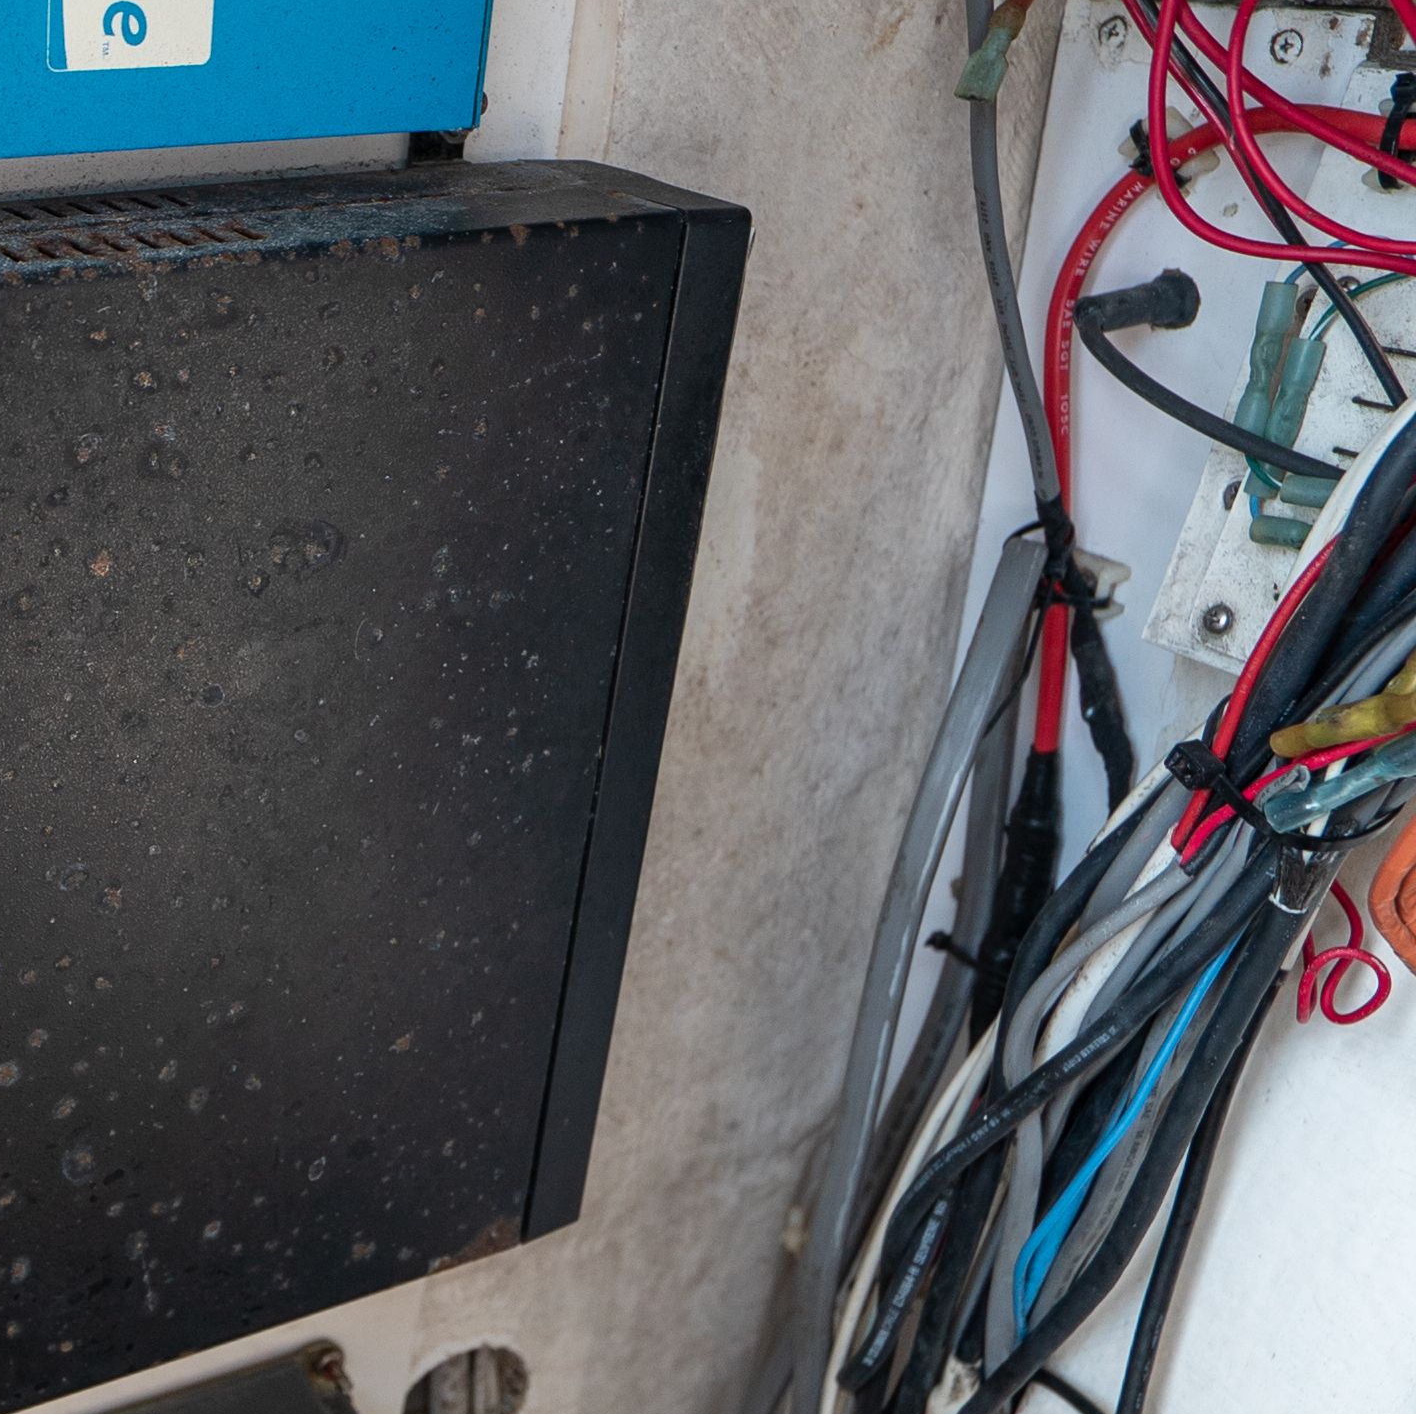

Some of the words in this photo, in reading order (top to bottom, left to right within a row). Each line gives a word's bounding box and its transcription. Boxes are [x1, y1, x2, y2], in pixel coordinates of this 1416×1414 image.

[1100, 181, 1144, 229] MARINE
[1075, 239, 1101, 277] WIRE
[1062, 299, 1075, 328] SAE
[1059, 340, 1070, 371] SGT
[1059, 394, 1070, 435] 105C
